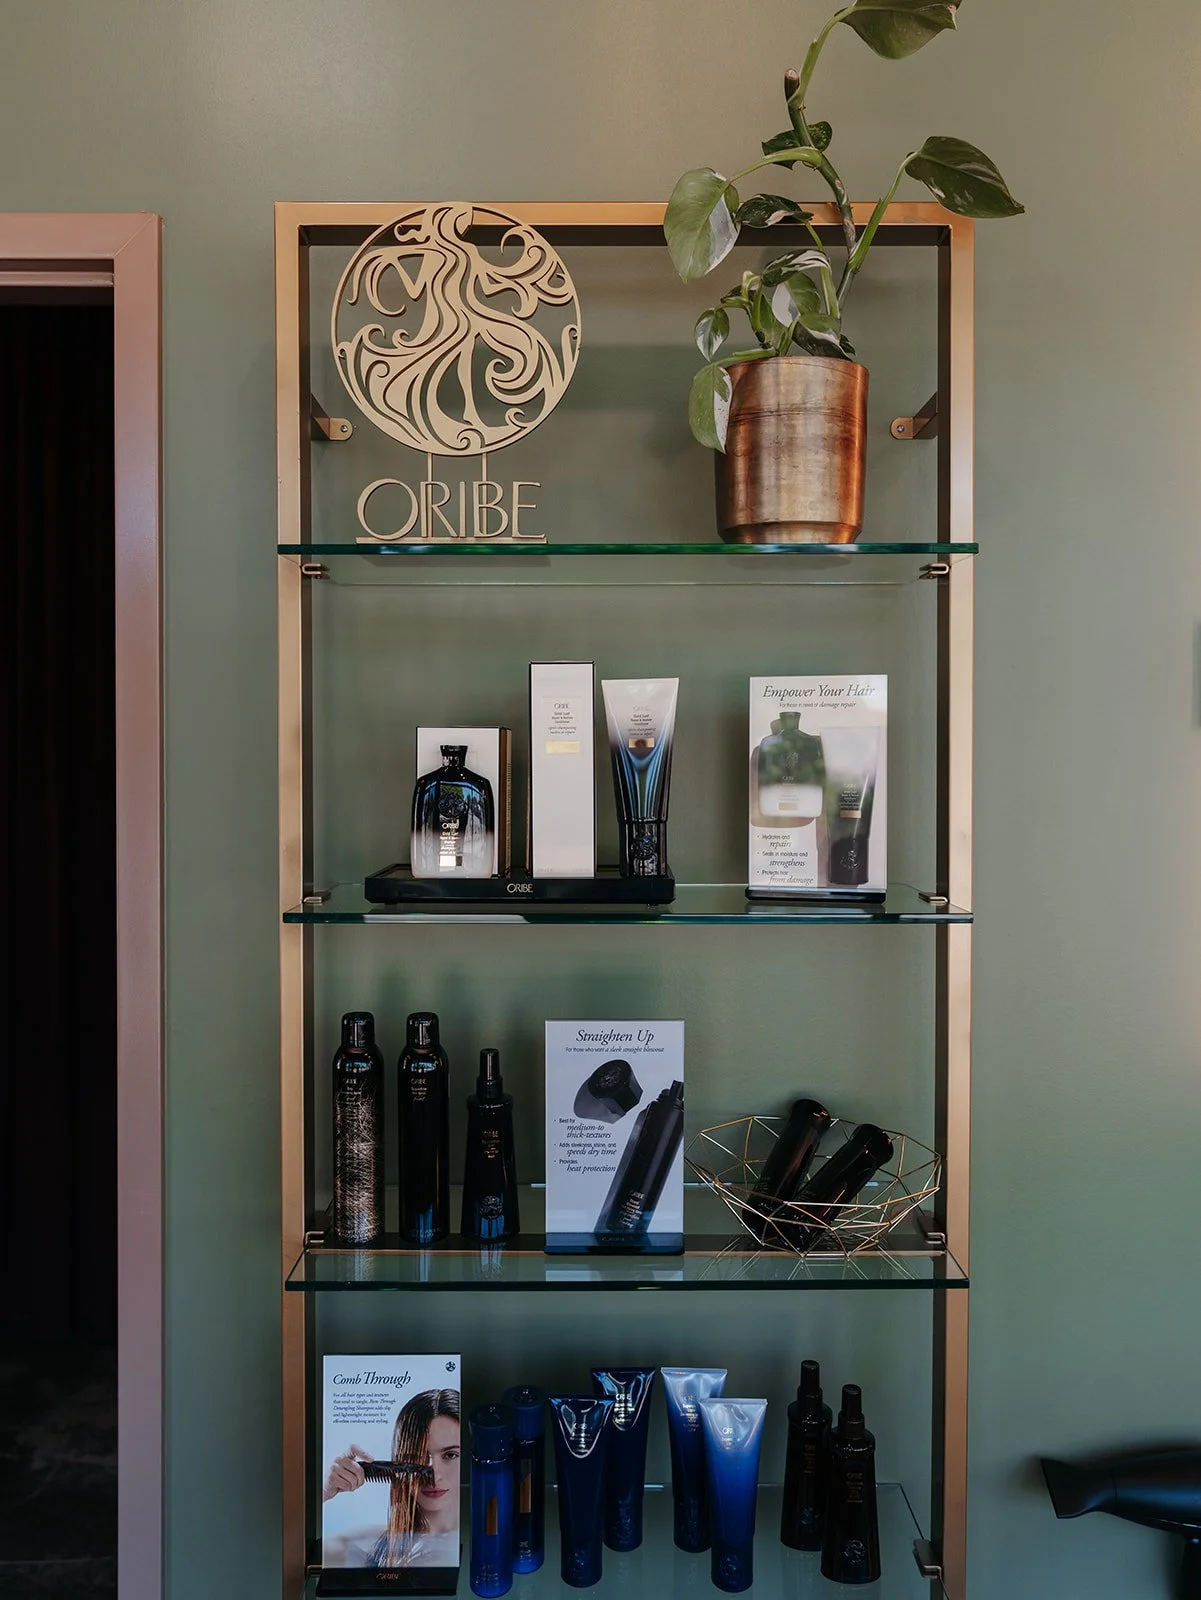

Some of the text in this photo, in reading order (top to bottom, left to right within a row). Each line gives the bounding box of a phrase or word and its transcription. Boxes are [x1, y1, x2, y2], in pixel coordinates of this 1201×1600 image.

[357, 478, 546, 540] ORIBE
[762, 684, 876, 701] Empower Your Hair
[769, 840, 791, 849] repairs
[769, 858, 805, 868] strengthens
[768, 876, 813, 885] from damage
[506, 883, 533, 893] ORIBE
[576, 1029, 654, 1045] Straighten Up
[566, 1148, 587, 1157] speeds
[588, 1148, 600, 1157] dry
[582, 1165, 616, 1174] protection
[333, 1371, 411, 1388] Comb Through
